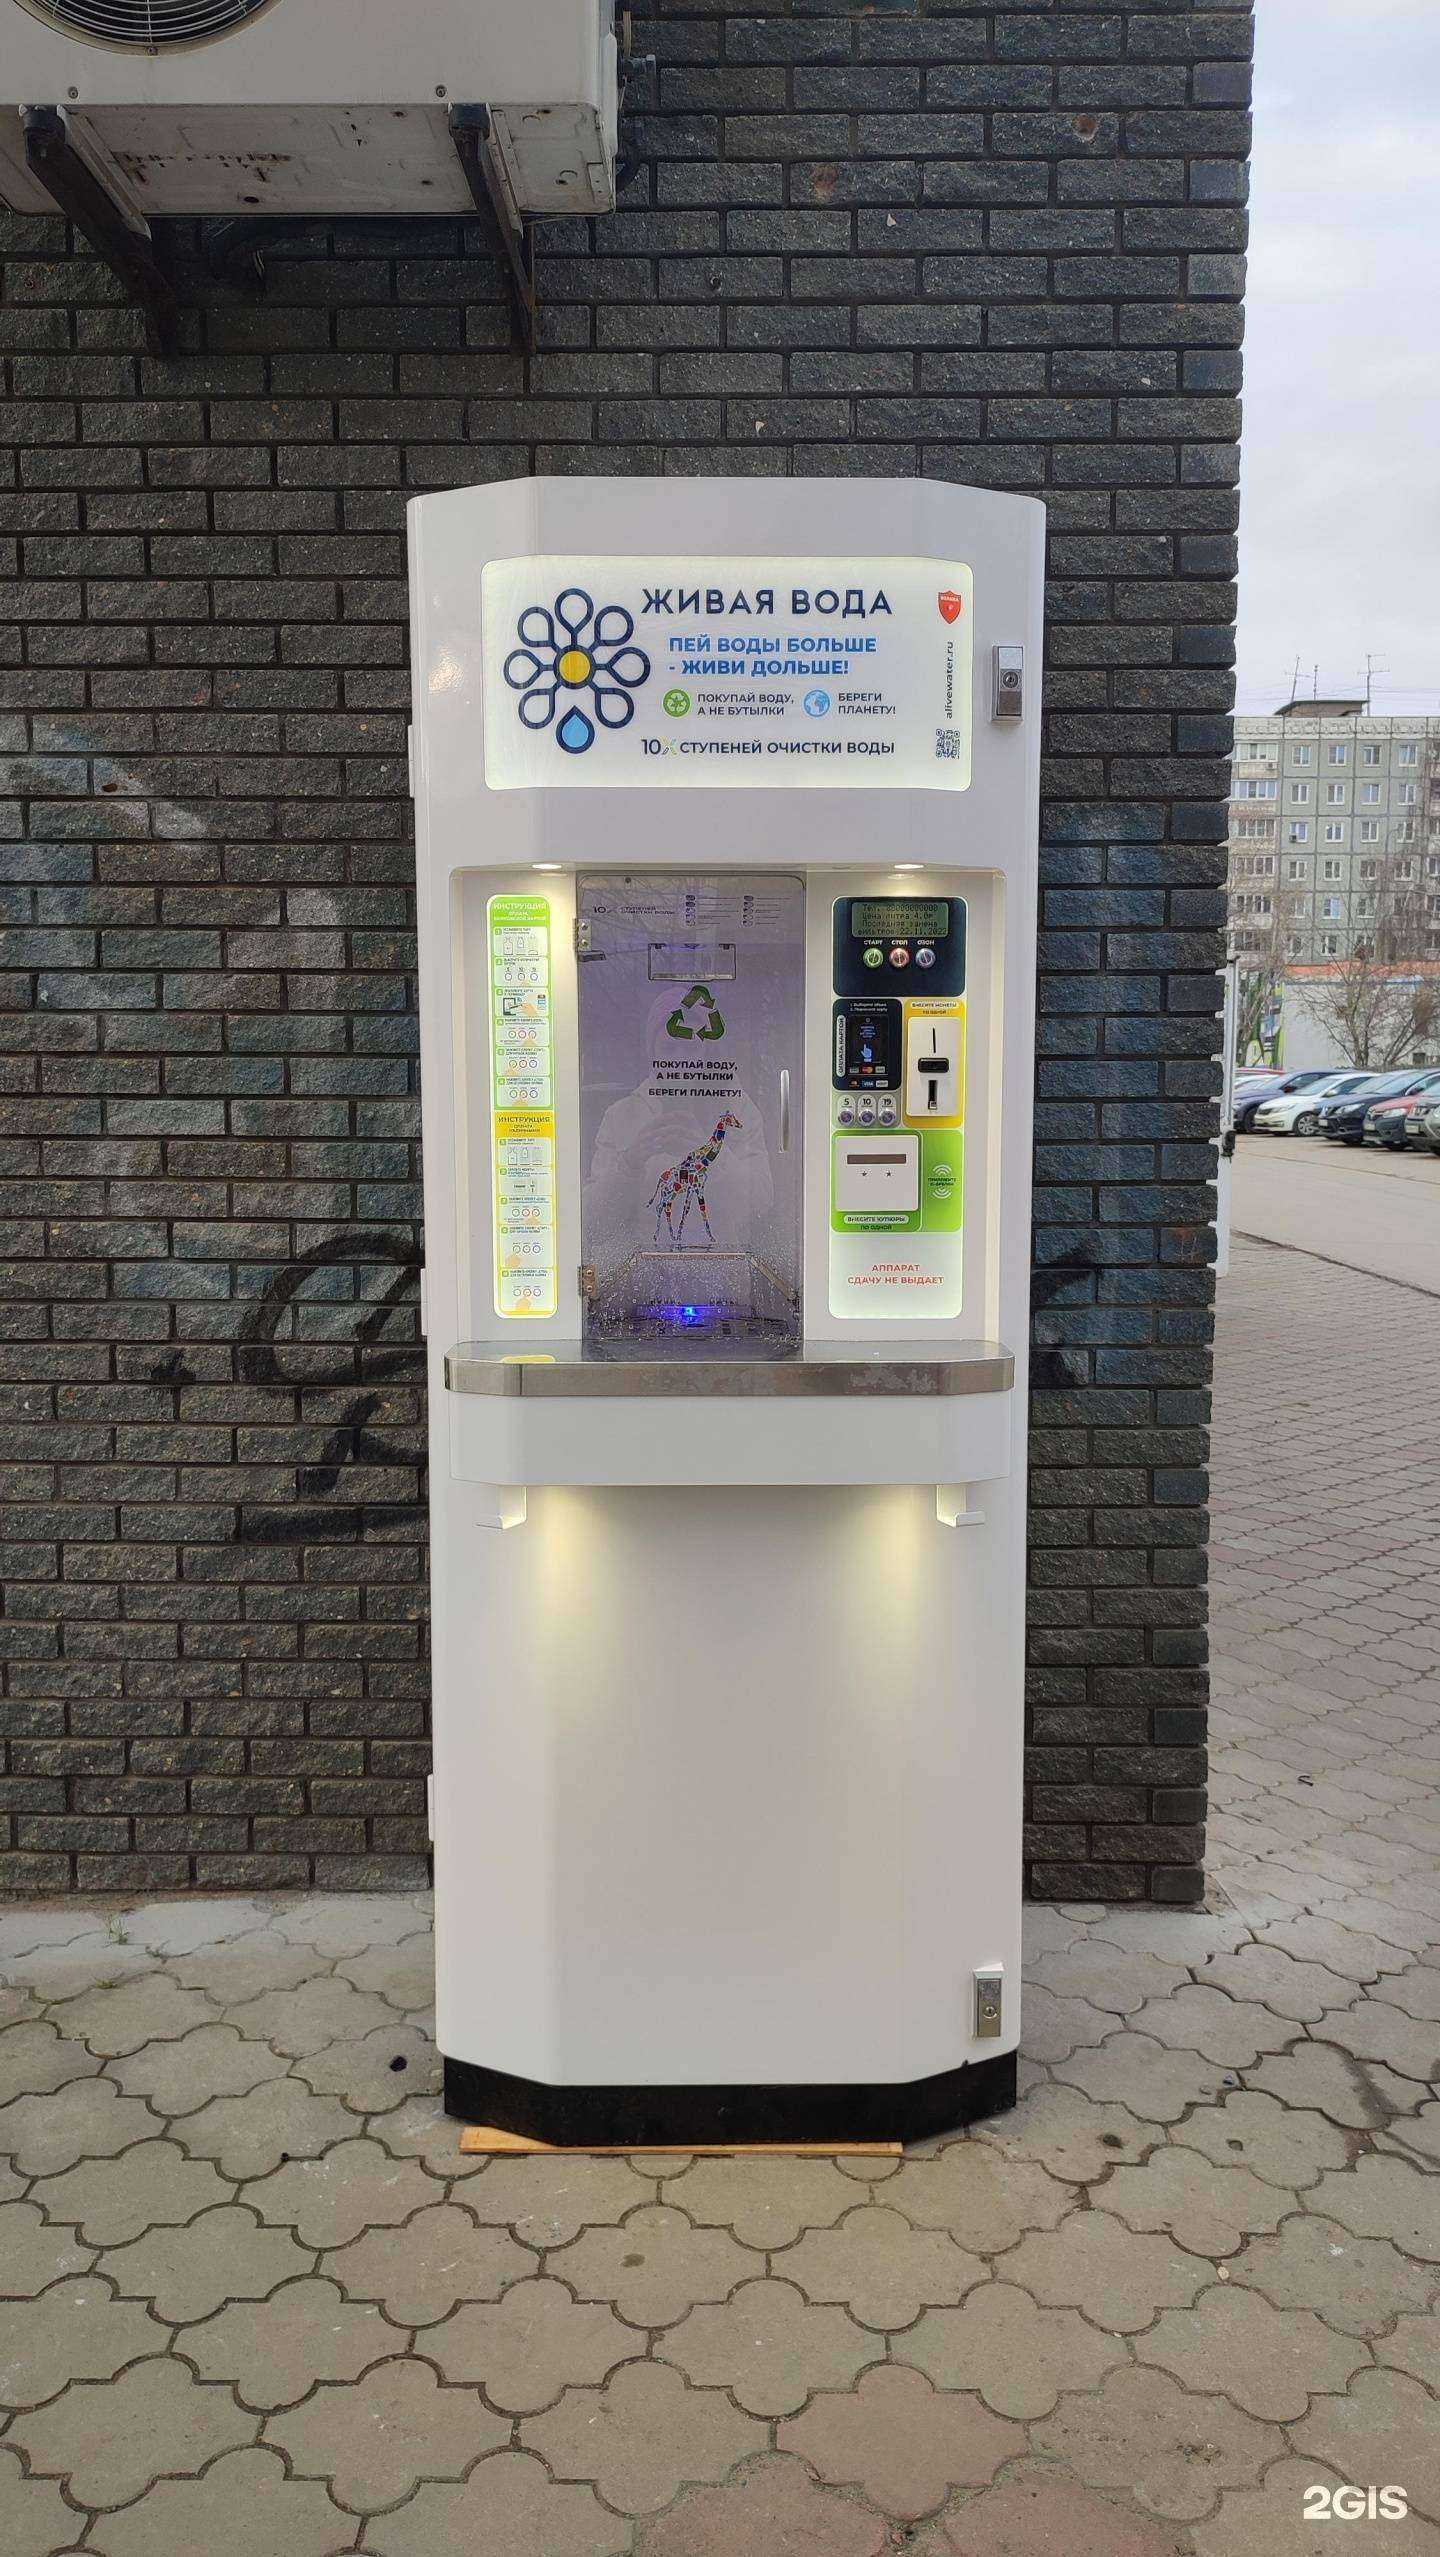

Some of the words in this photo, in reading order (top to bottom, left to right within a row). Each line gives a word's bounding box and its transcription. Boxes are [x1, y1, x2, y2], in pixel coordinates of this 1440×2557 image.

[641, 589, 774, 614] ЖИВАЯ
[792, 589, 893, 619] ВОДА
[669, 634, 711, 653] ПЕЙ
[717, 637, 780, 655] ВОДЫ
[787, 637, 877, 653] БОЛЬШЕ
[681, 660, 745, 675] ЖИВИ
[751, 660, 849, 677] ДОЛЬШЕ!
[945, 641, 954, 719] alivewater.ru
[697, 691, 756, 703] ПОКУПАЙ
[759, 693, 794, 705] ВОДУ,
[838, 692, 882, 702] БЕРЕГИ
[697, 706, 706, 715] А
[709, 706, 725, 716] НЕ
[728, 706, 785, 716] БУТЫЛКИ
[838, 705, 896, 715] ПЛАНЕТУ!
[680, 739, 762, 755] СТУПЕНЕЙ
[767, 742, 842, 754] ОЧИСТКИ
[847, 742, 895, 755] ВОДЫ
[652, 1060, 704, 1069] ПОКУПАЙ
[706, 1061, 738, 1071] ВОДУ,
[667, 1072, 680, 1080] НЕ
[683, 1072, 734, 1081] БУТЫЛКИ
[649, 1088, 687, 1097] БЕРЕГИ
[690, 1088, 742, 1098] ПЛАНЕТУ!
[844, 1098, 850, 1106] 5
[863, 1098, 872, 1106] 10
[882, 1098, 892, 1106] 19
[872, 1264, 921, 1272] АППАРАТ
[847, 1276, 881, 1285] СДАЧУ
[884, 1276, 898, 1284] НЕ
[900, 1276, 944, 1285] ВЫДАЕТ
